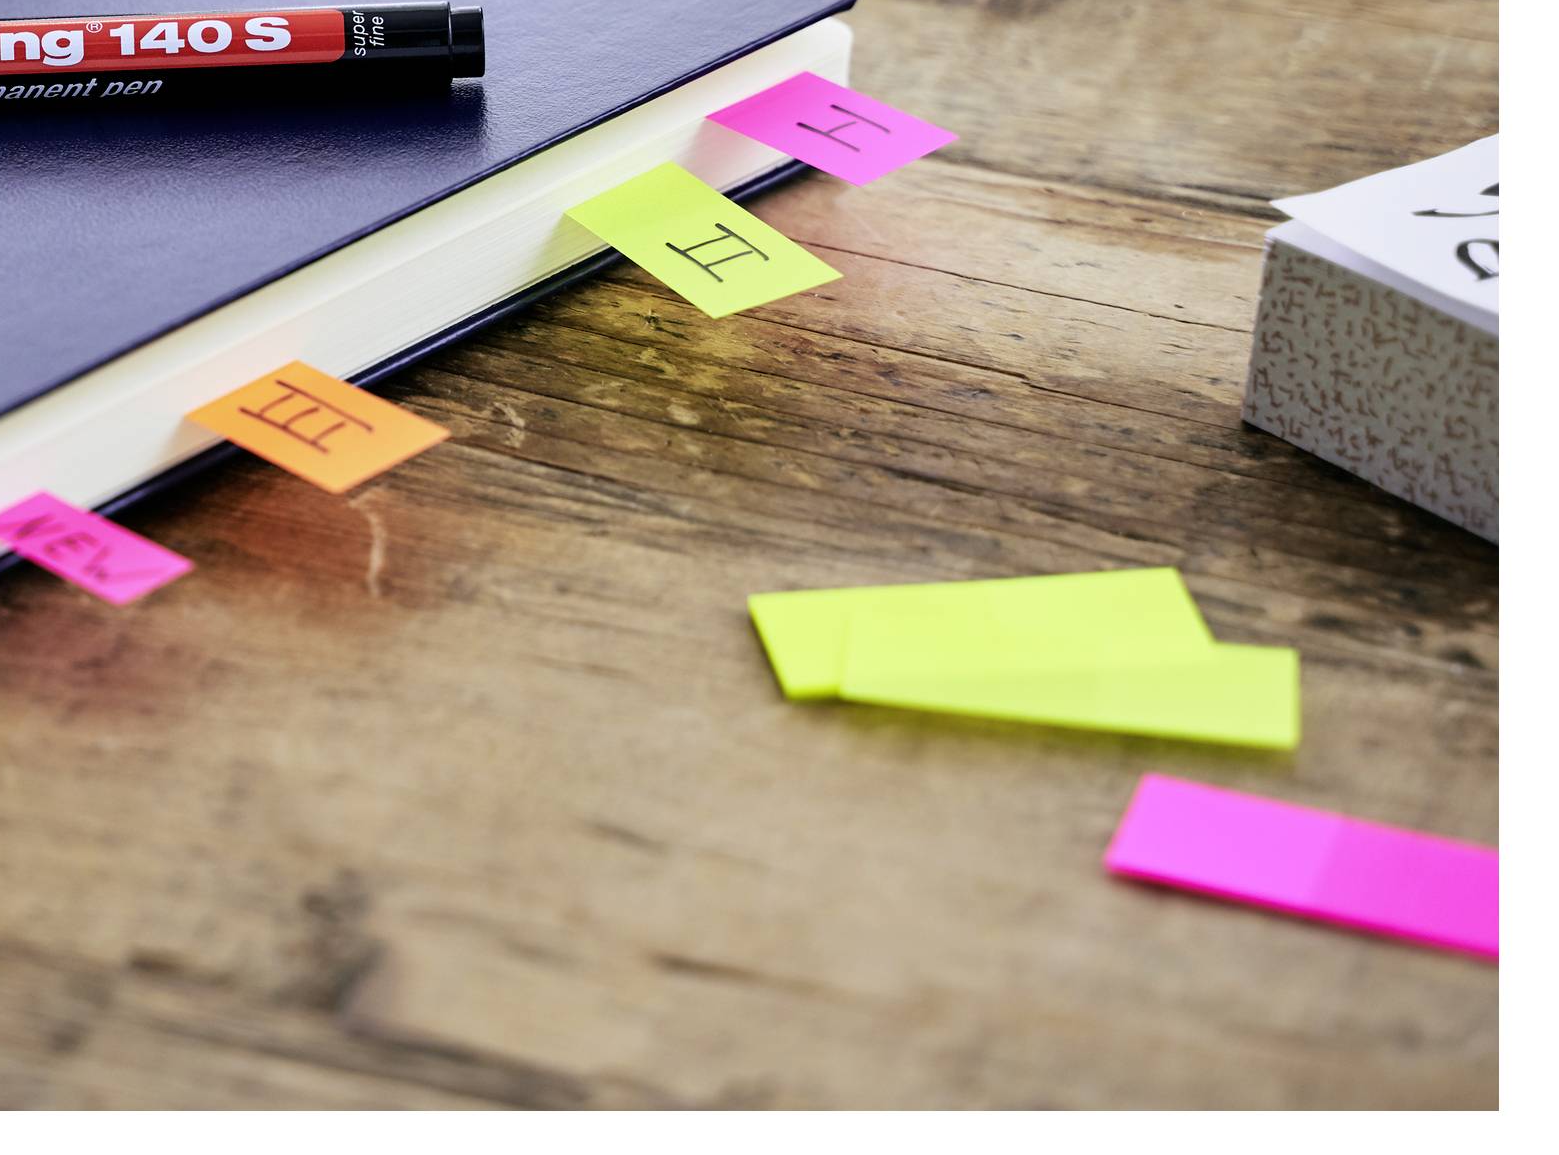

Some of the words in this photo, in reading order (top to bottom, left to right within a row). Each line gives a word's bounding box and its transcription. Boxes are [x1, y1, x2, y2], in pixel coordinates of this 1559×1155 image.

[109, 20, 233, 56] 140
[244, 16, 292, 52] S
[352, 10, 369, 56] super
[369, 16, 385, 46] fine
[100, 78, 163, 98] pen
